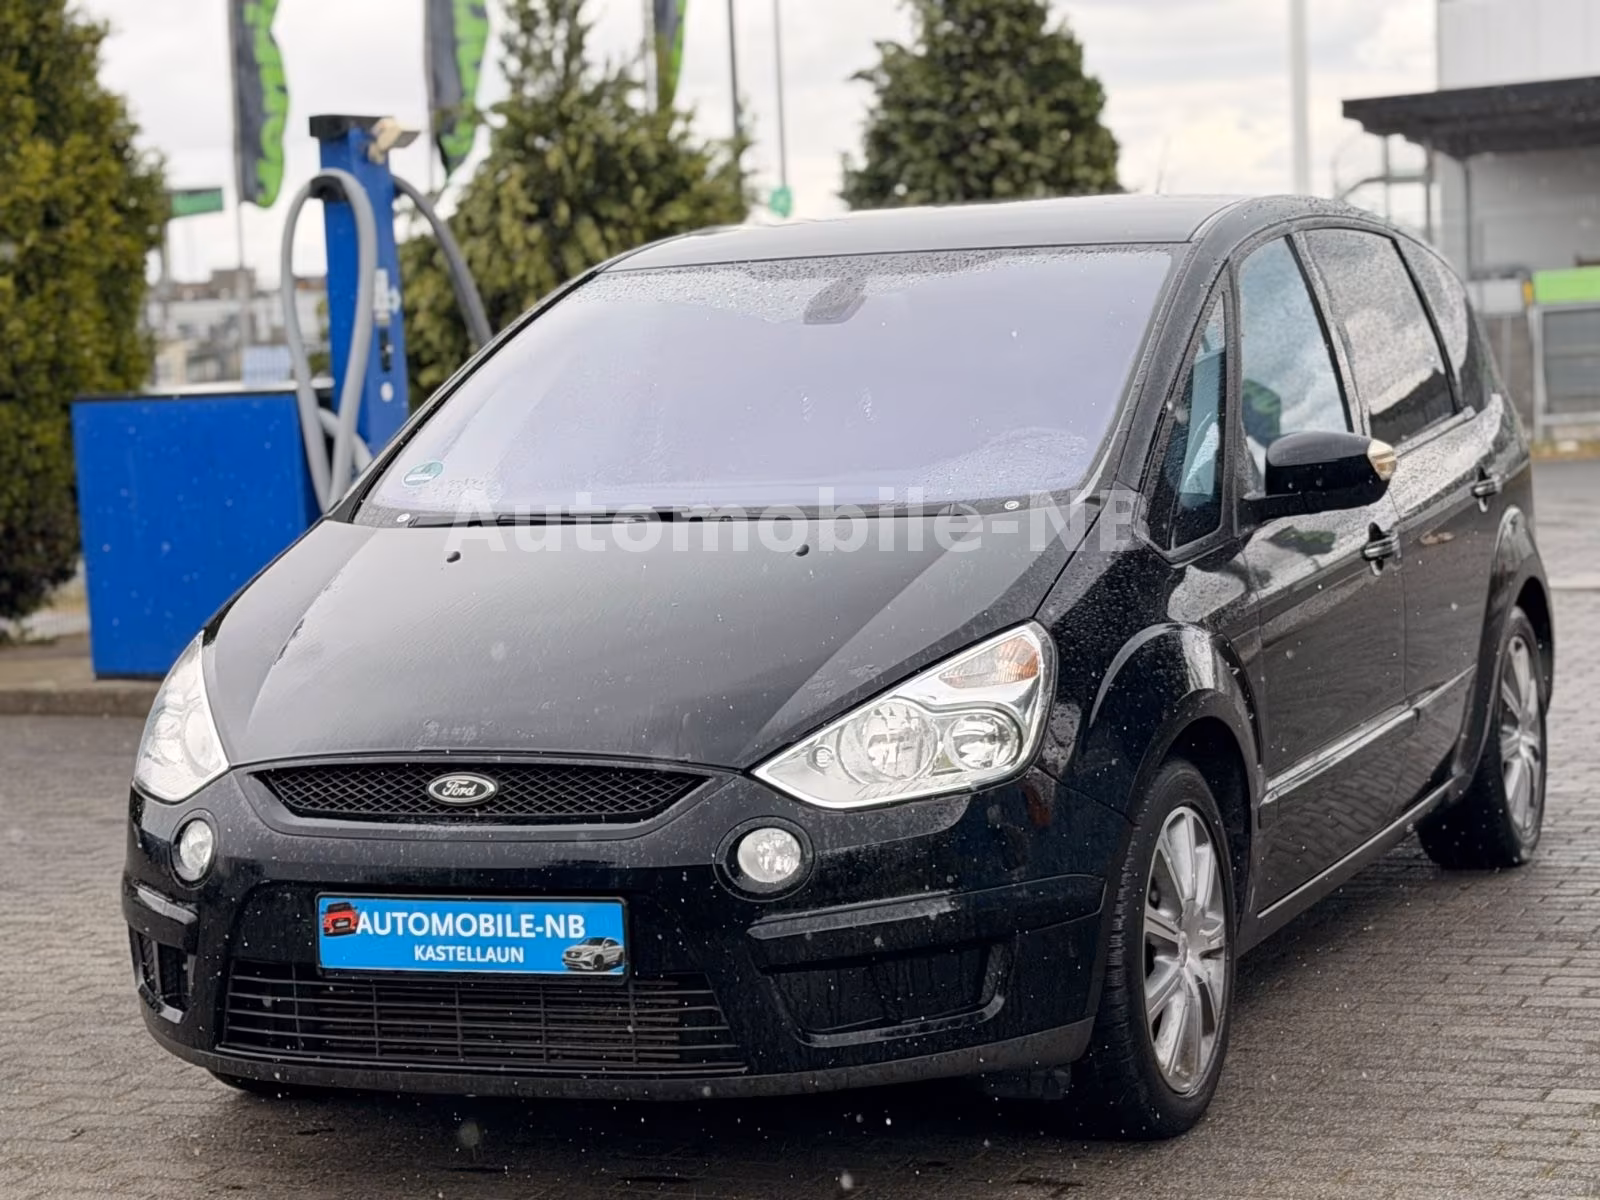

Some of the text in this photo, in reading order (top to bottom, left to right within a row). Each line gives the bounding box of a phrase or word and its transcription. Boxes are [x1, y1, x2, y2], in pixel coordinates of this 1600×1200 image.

[442, 779, 477, 796] Ford
[356, 910, 585, 939] AUTOMOBILE-NB
[414, 944, 525, 963] KASTELLAUN
